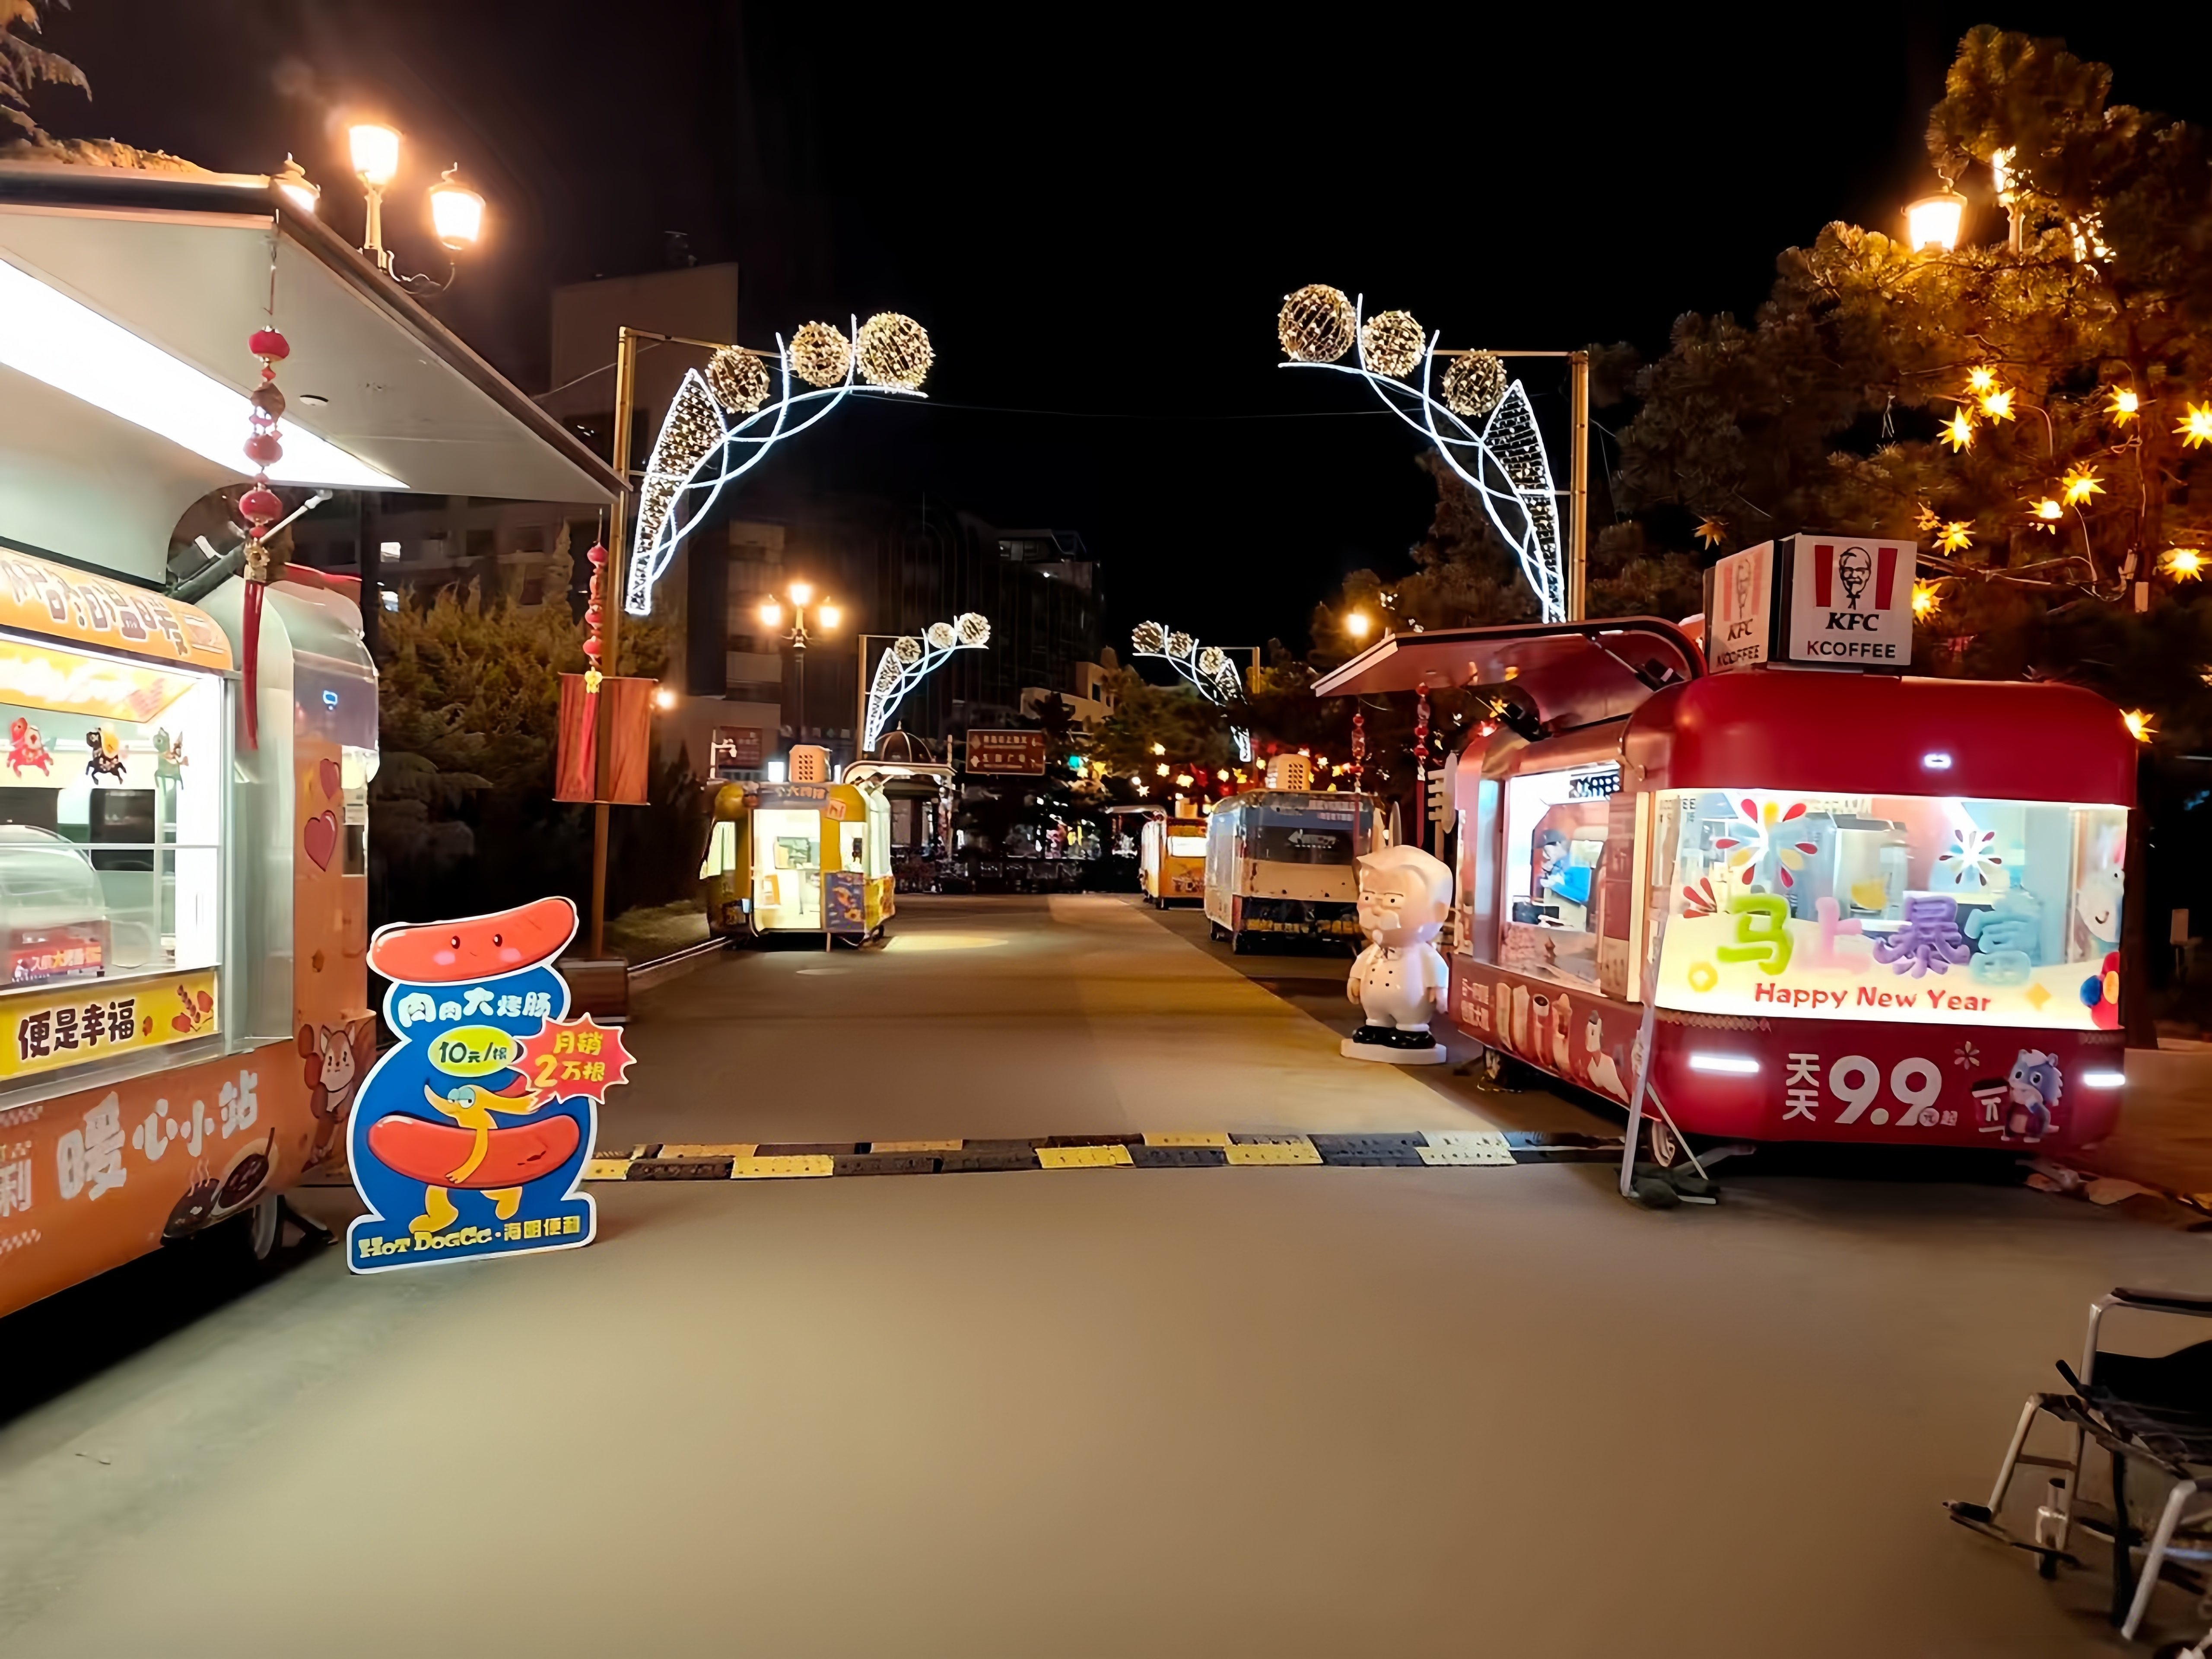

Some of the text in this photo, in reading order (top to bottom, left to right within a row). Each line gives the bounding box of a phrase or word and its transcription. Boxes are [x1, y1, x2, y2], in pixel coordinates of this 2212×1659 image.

[1728, 618, 1753, 641] KFC
[1825, 613, 1879, 631] KFC
[1807, 641, 1896, 658] KCOFFEE
[1716, 893, 2041, 986] 马上暴富
[398, 987, 552, 1028] 肉肉大烤肠
[1754, 983, 1991, 1012] Happy New Year
[18, 999, 135, 1060] 便是幸福
[553, 1031, 604, 1055] 月销
[534, 1054, 605, 1088] 2万根
[1783, 1053, 1821, 1122] 天天
[1829, 1055, 1942, 1126] 9.9
[56, 1070, 258, 1201] 暖心小站
